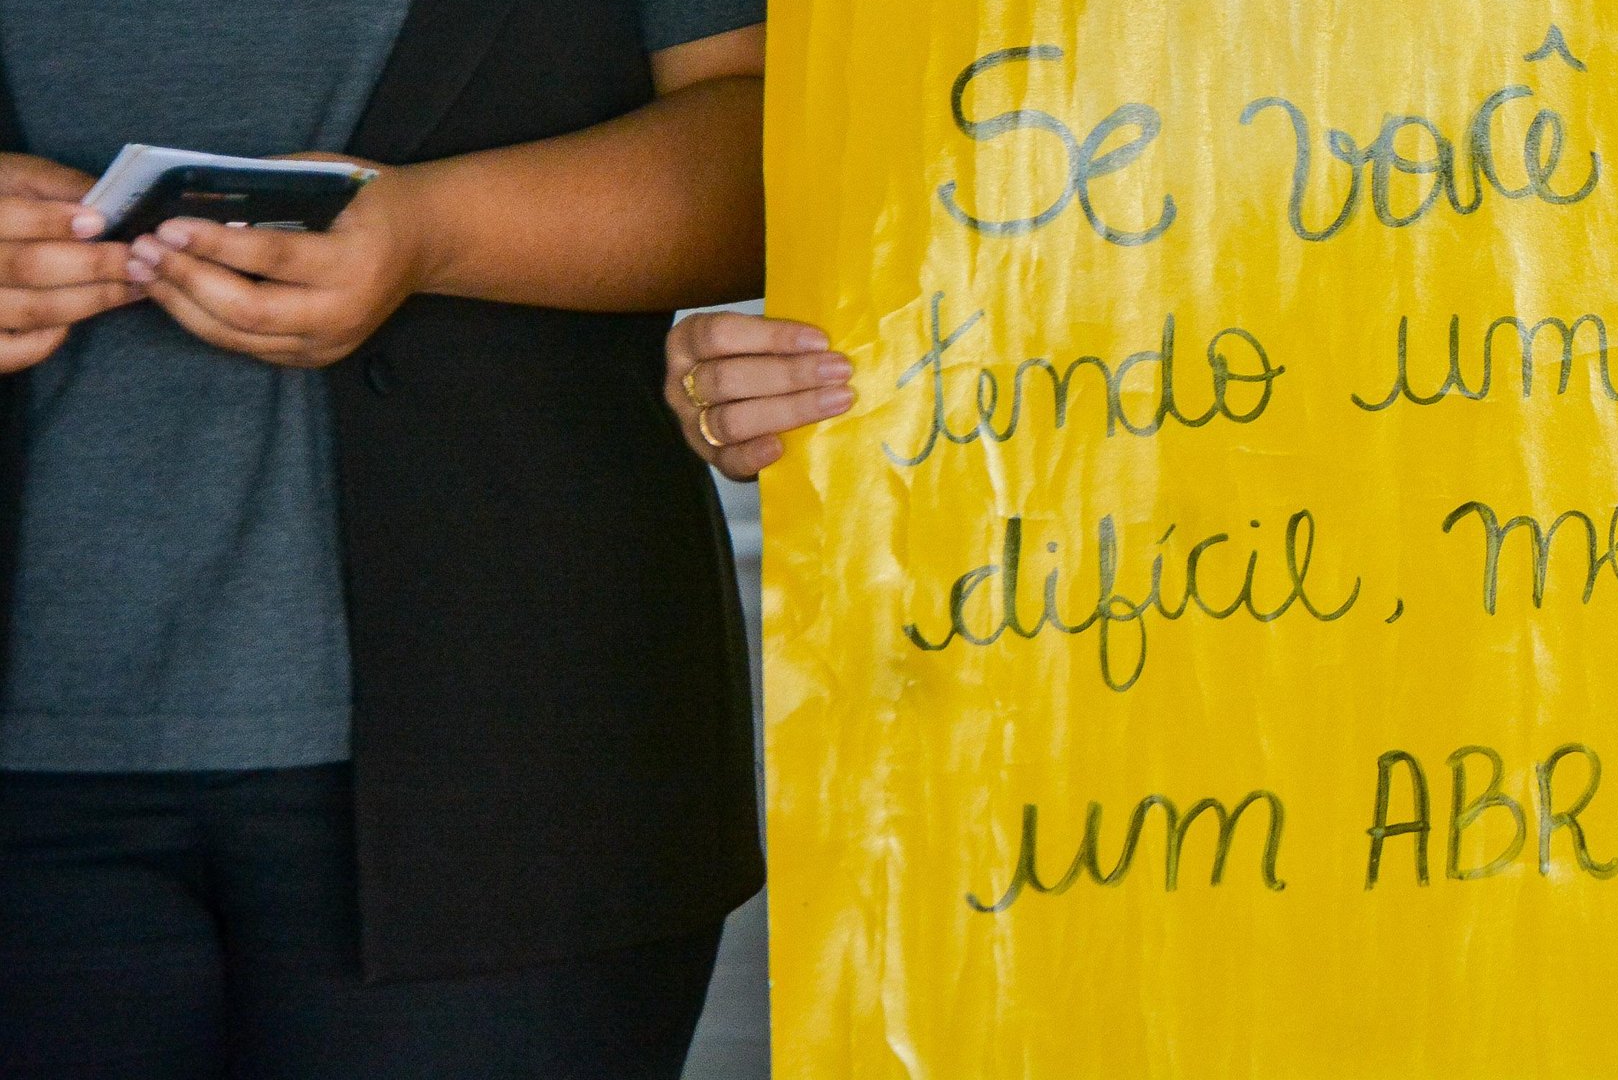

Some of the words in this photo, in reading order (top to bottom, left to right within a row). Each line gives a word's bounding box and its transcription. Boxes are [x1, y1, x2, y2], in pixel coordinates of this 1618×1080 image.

[936, 43, 1178, 247] Se
[1237, 23, 1601, 243] você
[881, 290, 1286, 467] tendo
[965, 788, 1288, 915] um
